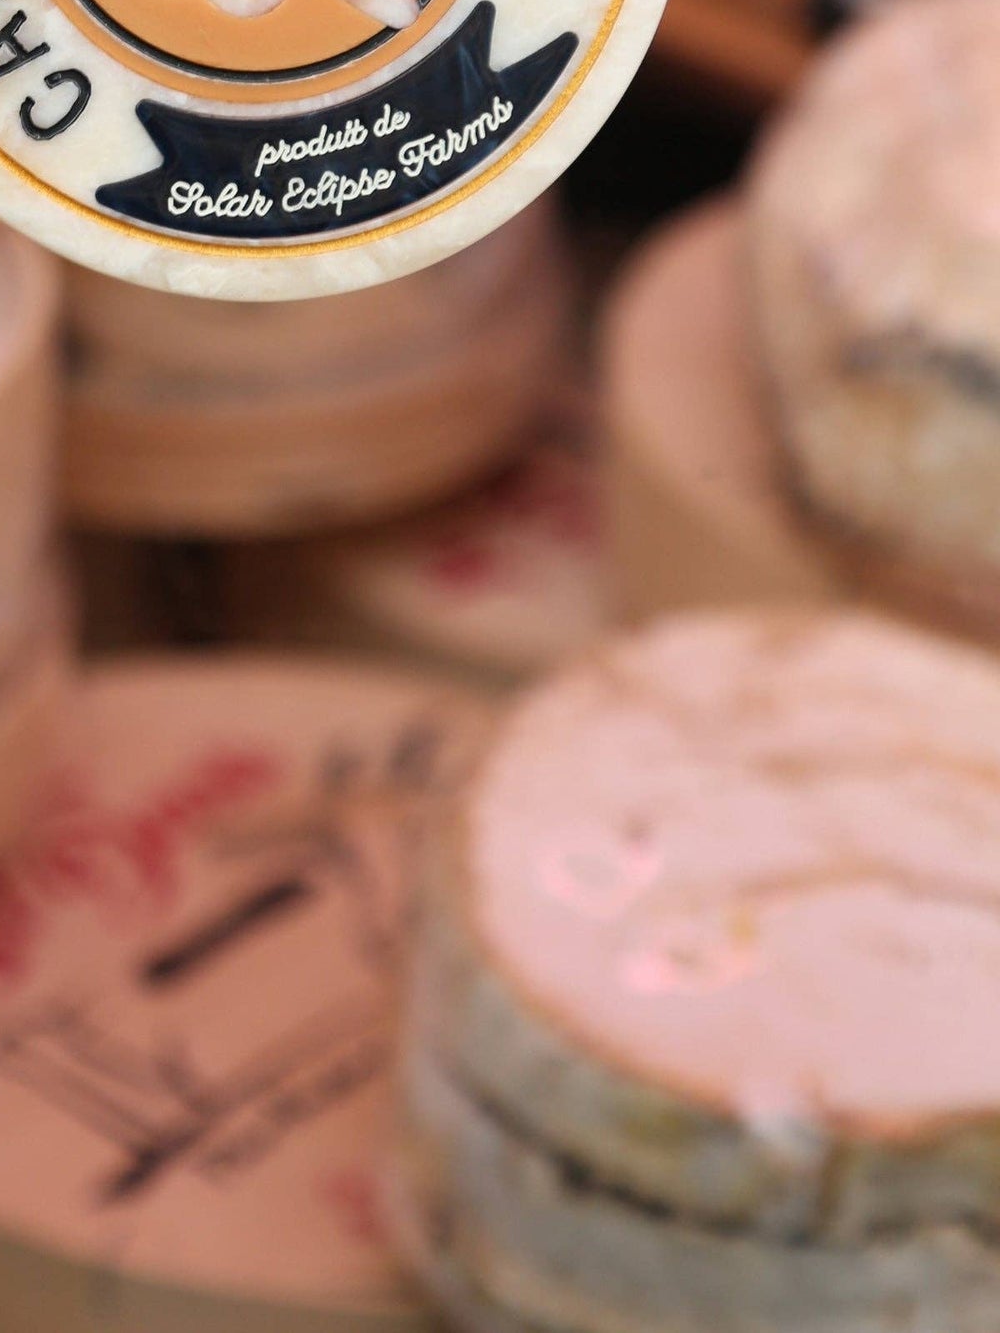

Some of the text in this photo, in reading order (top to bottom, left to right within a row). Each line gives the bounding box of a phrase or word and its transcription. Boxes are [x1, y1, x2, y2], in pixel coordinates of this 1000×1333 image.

[167, 96, 514, 218] Solar Eclipse Farms
[255, 104, 410, 177] produit de
